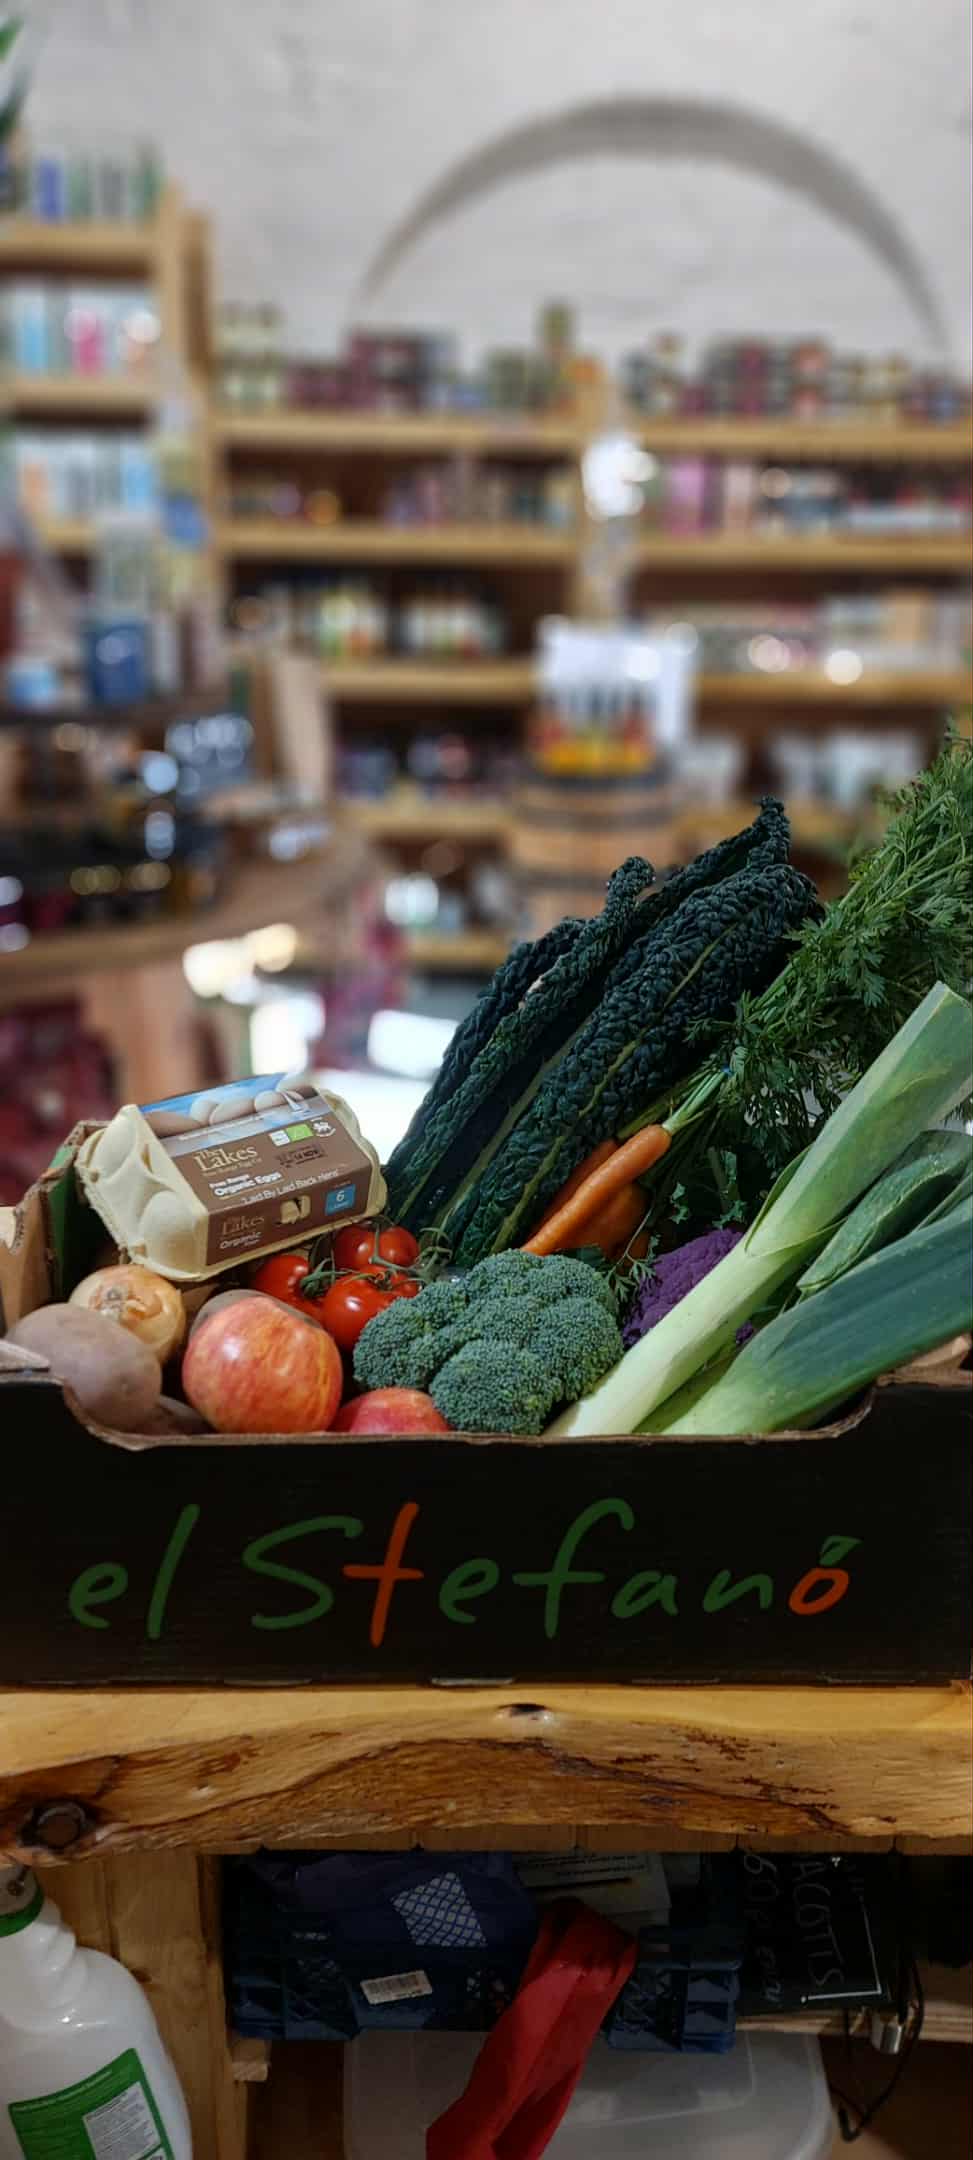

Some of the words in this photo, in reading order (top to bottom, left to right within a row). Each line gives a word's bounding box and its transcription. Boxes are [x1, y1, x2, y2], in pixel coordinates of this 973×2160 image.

[194, 1146, 257, 1172] Lakes
[214, 1180, 257, 1197] Organic
[255, 1171, 282, 1185] Eggs
[277, 1182, 296, 1196] Laid
[336, 1190, 345, 1202] 6
[219, 1231, 262, 1249] Organic
[69, 1503, 200, 1640] el
